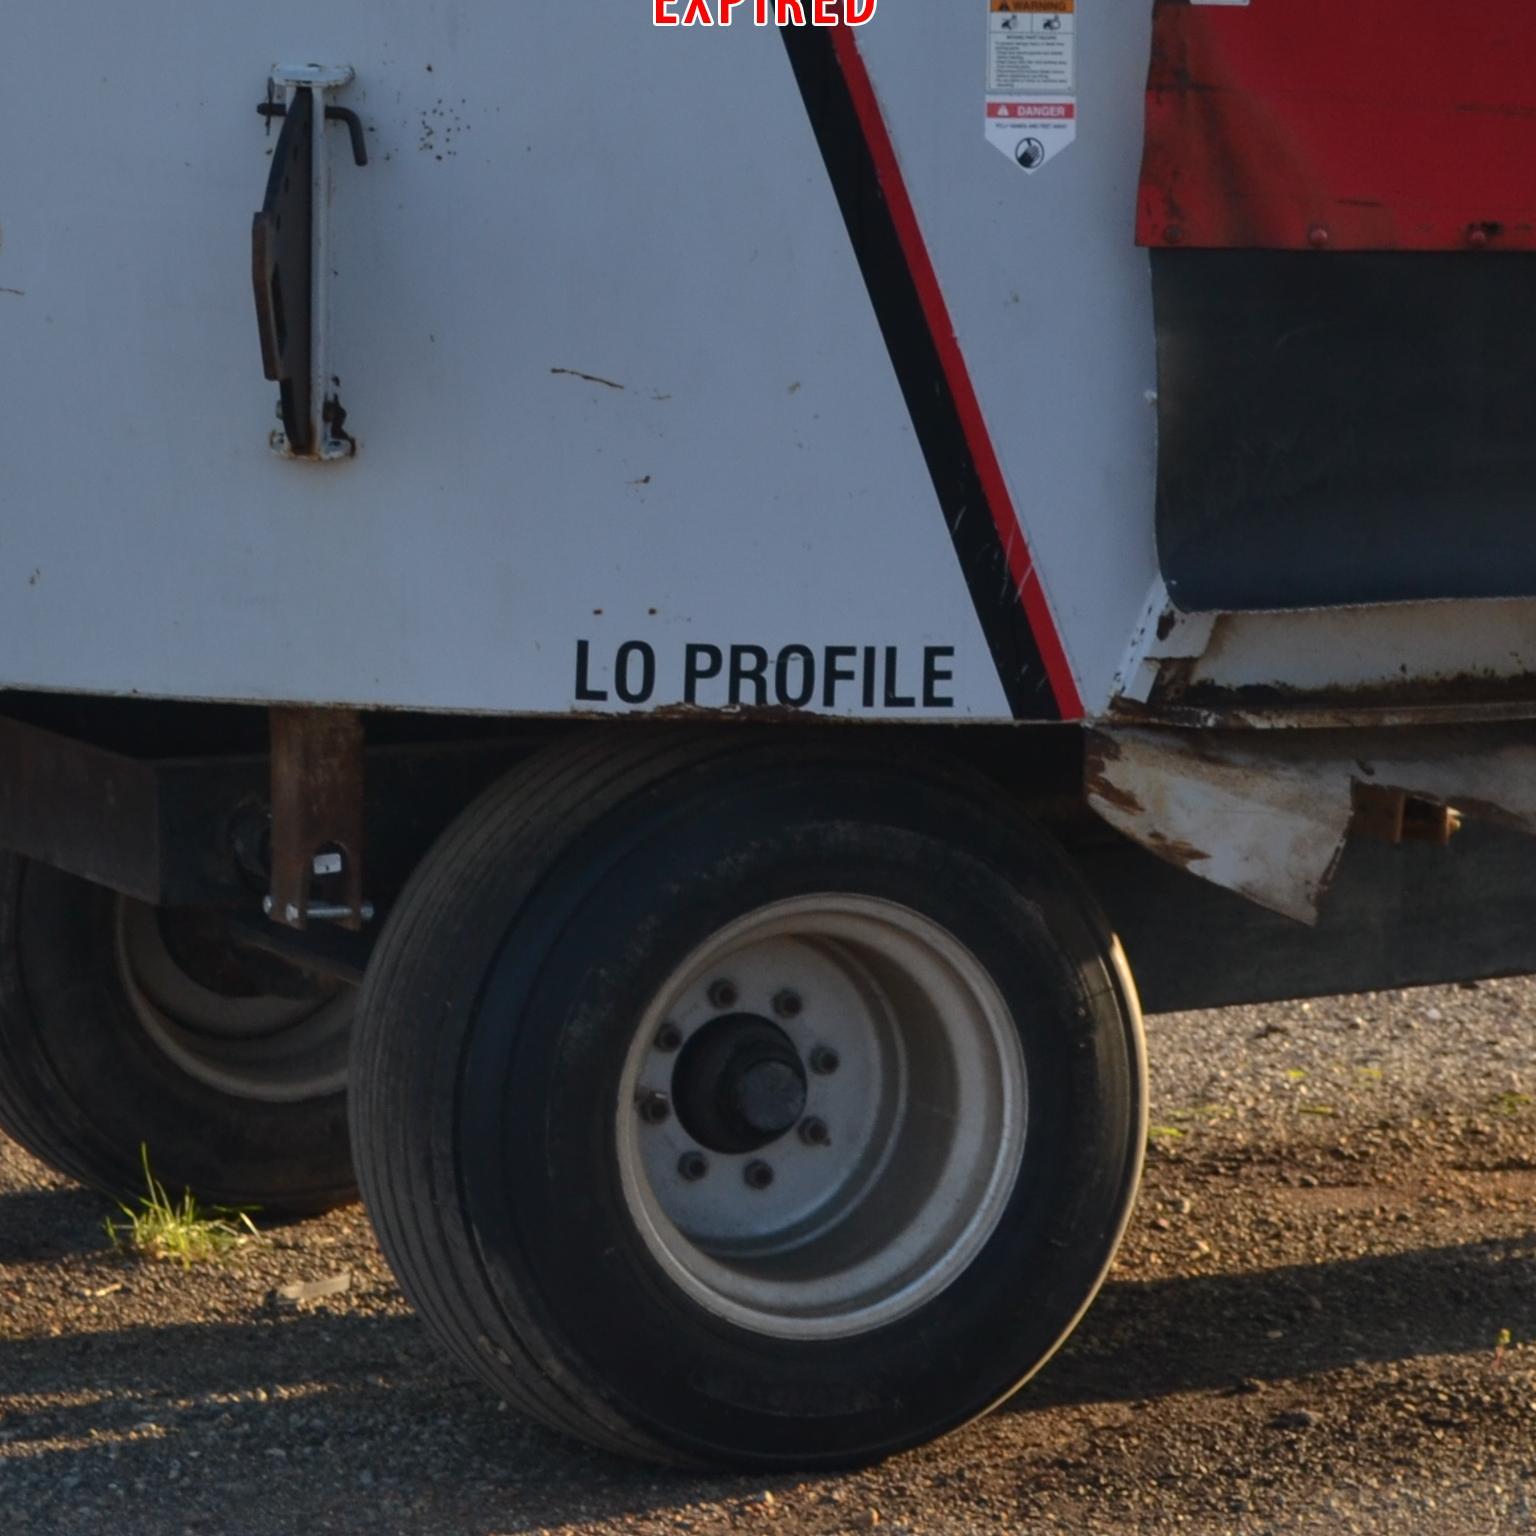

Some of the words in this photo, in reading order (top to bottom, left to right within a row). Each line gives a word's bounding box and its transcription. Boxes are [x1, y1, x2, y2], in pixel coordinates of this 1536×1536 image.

[1017, 105, 1066, 117] DANGER
[574, 639, 657, 705] LO
[682, 642, 956, 709] PROFILE
